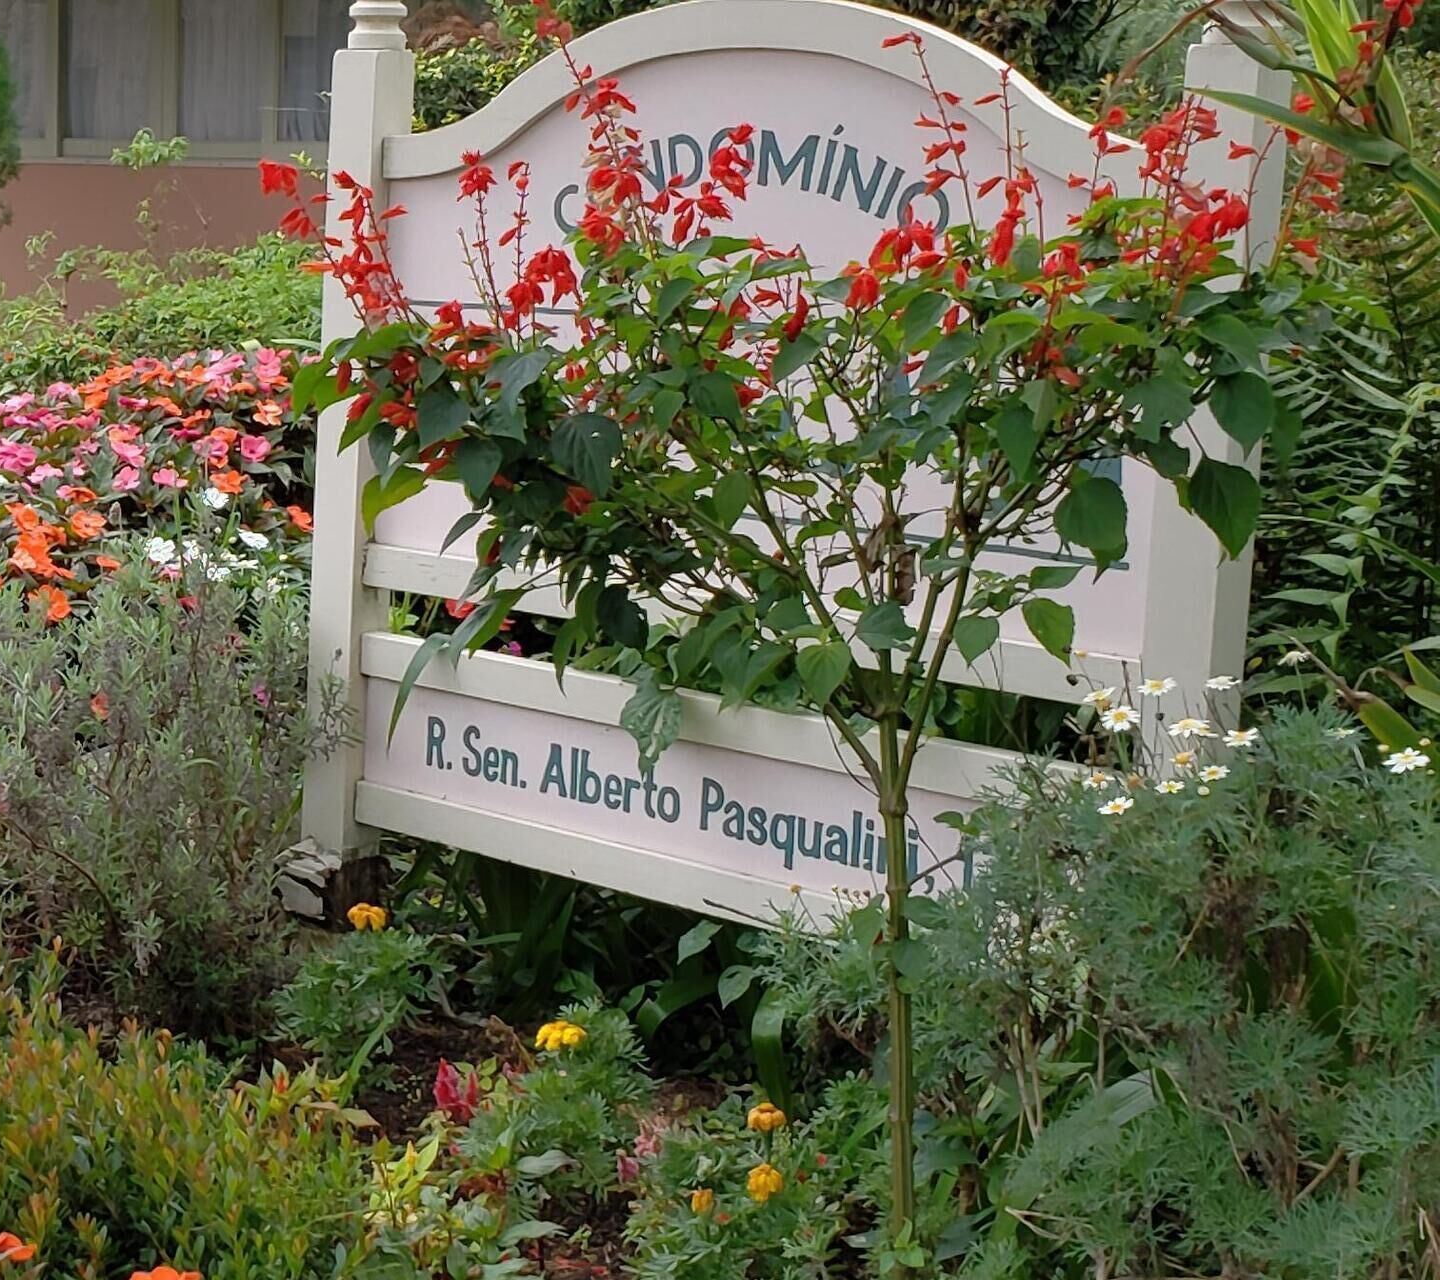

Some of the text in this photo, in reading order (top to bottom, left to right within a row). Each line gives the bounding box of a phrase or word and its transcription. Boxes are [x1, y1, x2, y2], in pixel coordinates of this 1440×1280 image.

[554, 124, 949, 237] CNDOMÍNIO
[426, 716, 452, 770] R.
[462, 725, 527, 789] Sen.
[540, 742, 680, 823] Alberto
